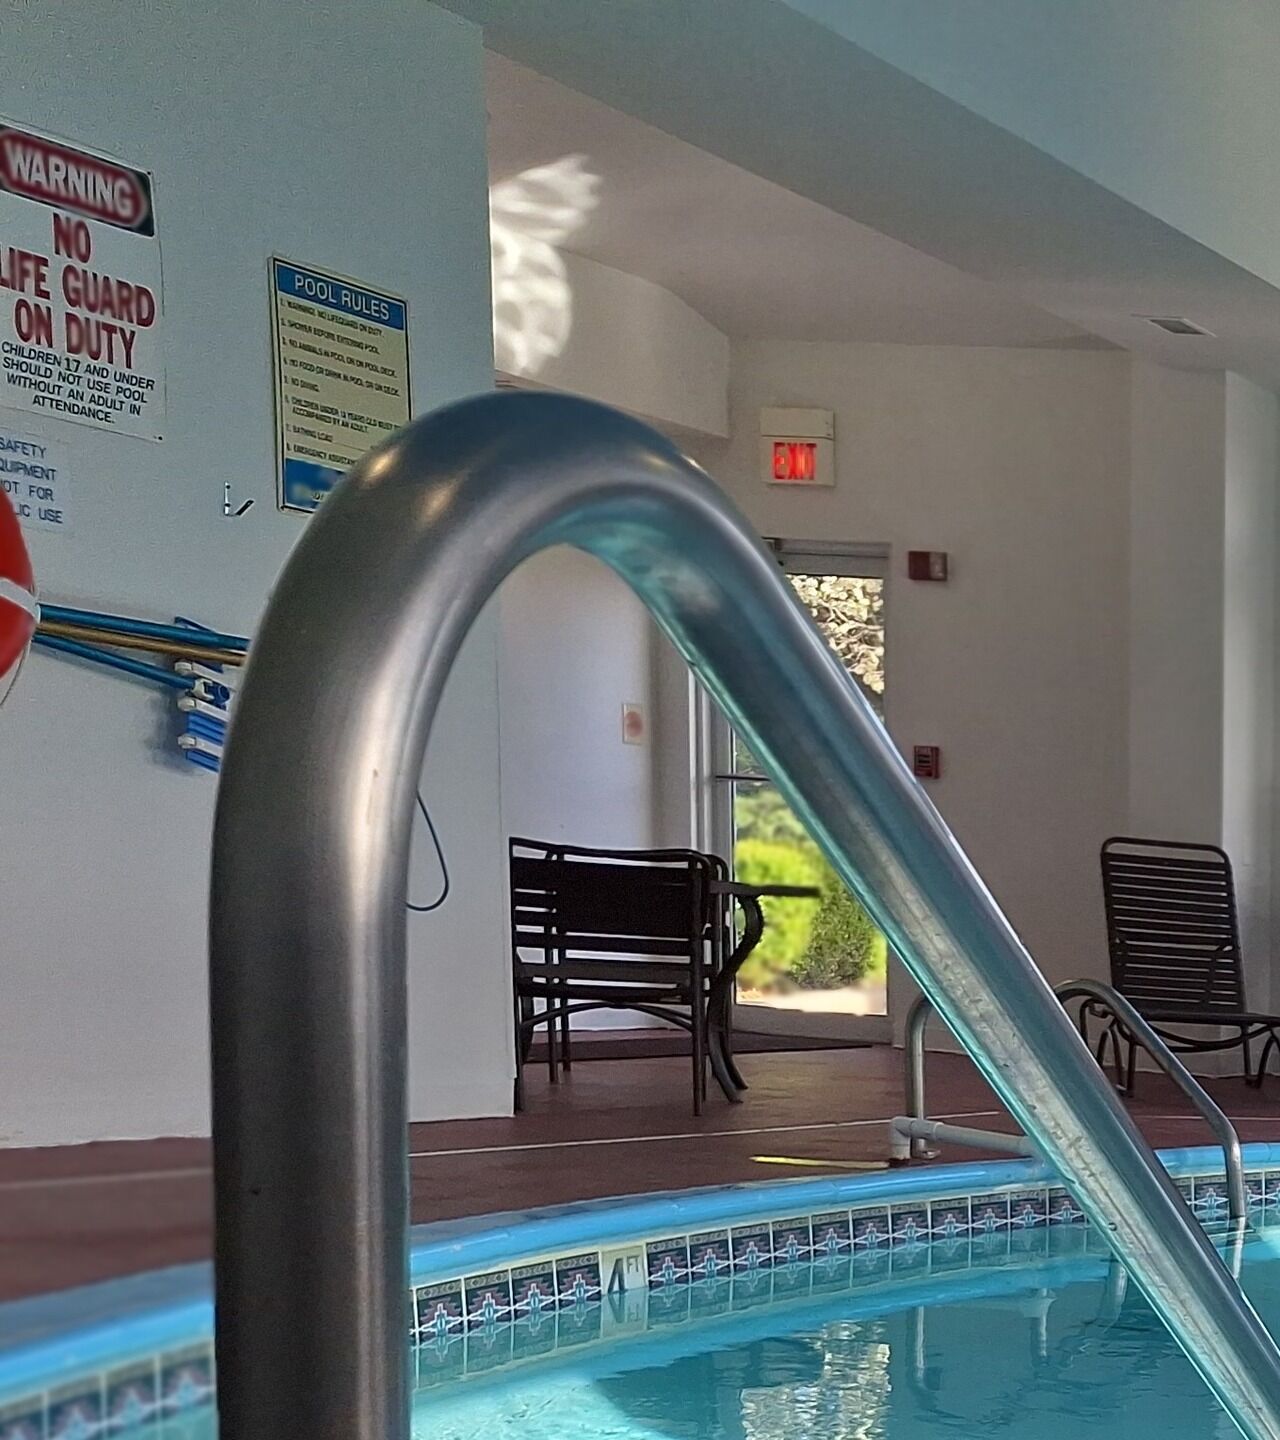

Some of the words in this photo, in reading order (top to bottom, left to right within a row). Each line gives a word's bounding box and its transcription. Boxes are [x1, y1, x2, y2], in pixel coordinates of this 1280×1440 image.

[4, 139, 133, 218] WARNING
[53, 212, 91, 263] NO
[62, 264, 155, 327] GUARD
[295, 274, 337, 304] POOL
[341, 290, 390, 320] RULES
[15, 298, 53, 348] ON
[65, 312, 136, 369] DUTY
[1, 341, 61, 367] CHILDREN
[65, 357, 81, 372] 17
[84, 364, 109, 379] AND
[114, 371, 156, 391] UNDER
[3, 357, 53, 379] SHOULD
[57, 371, 83, 386] NOT
[87, 378, 112, 394] USE
[115, 386, 148, 404] POOL
[6, 372, 63, 396] WITHOUT
[67, 389, 85, 401] AN
[89, 395, 126, 412] ADULT
[130, 404, 141, 416] IN
[32, 395, 115, 424] ATTENDANCE.
[29, 485, 54, 501] FOR
[39, 507, 63, 524] USE
